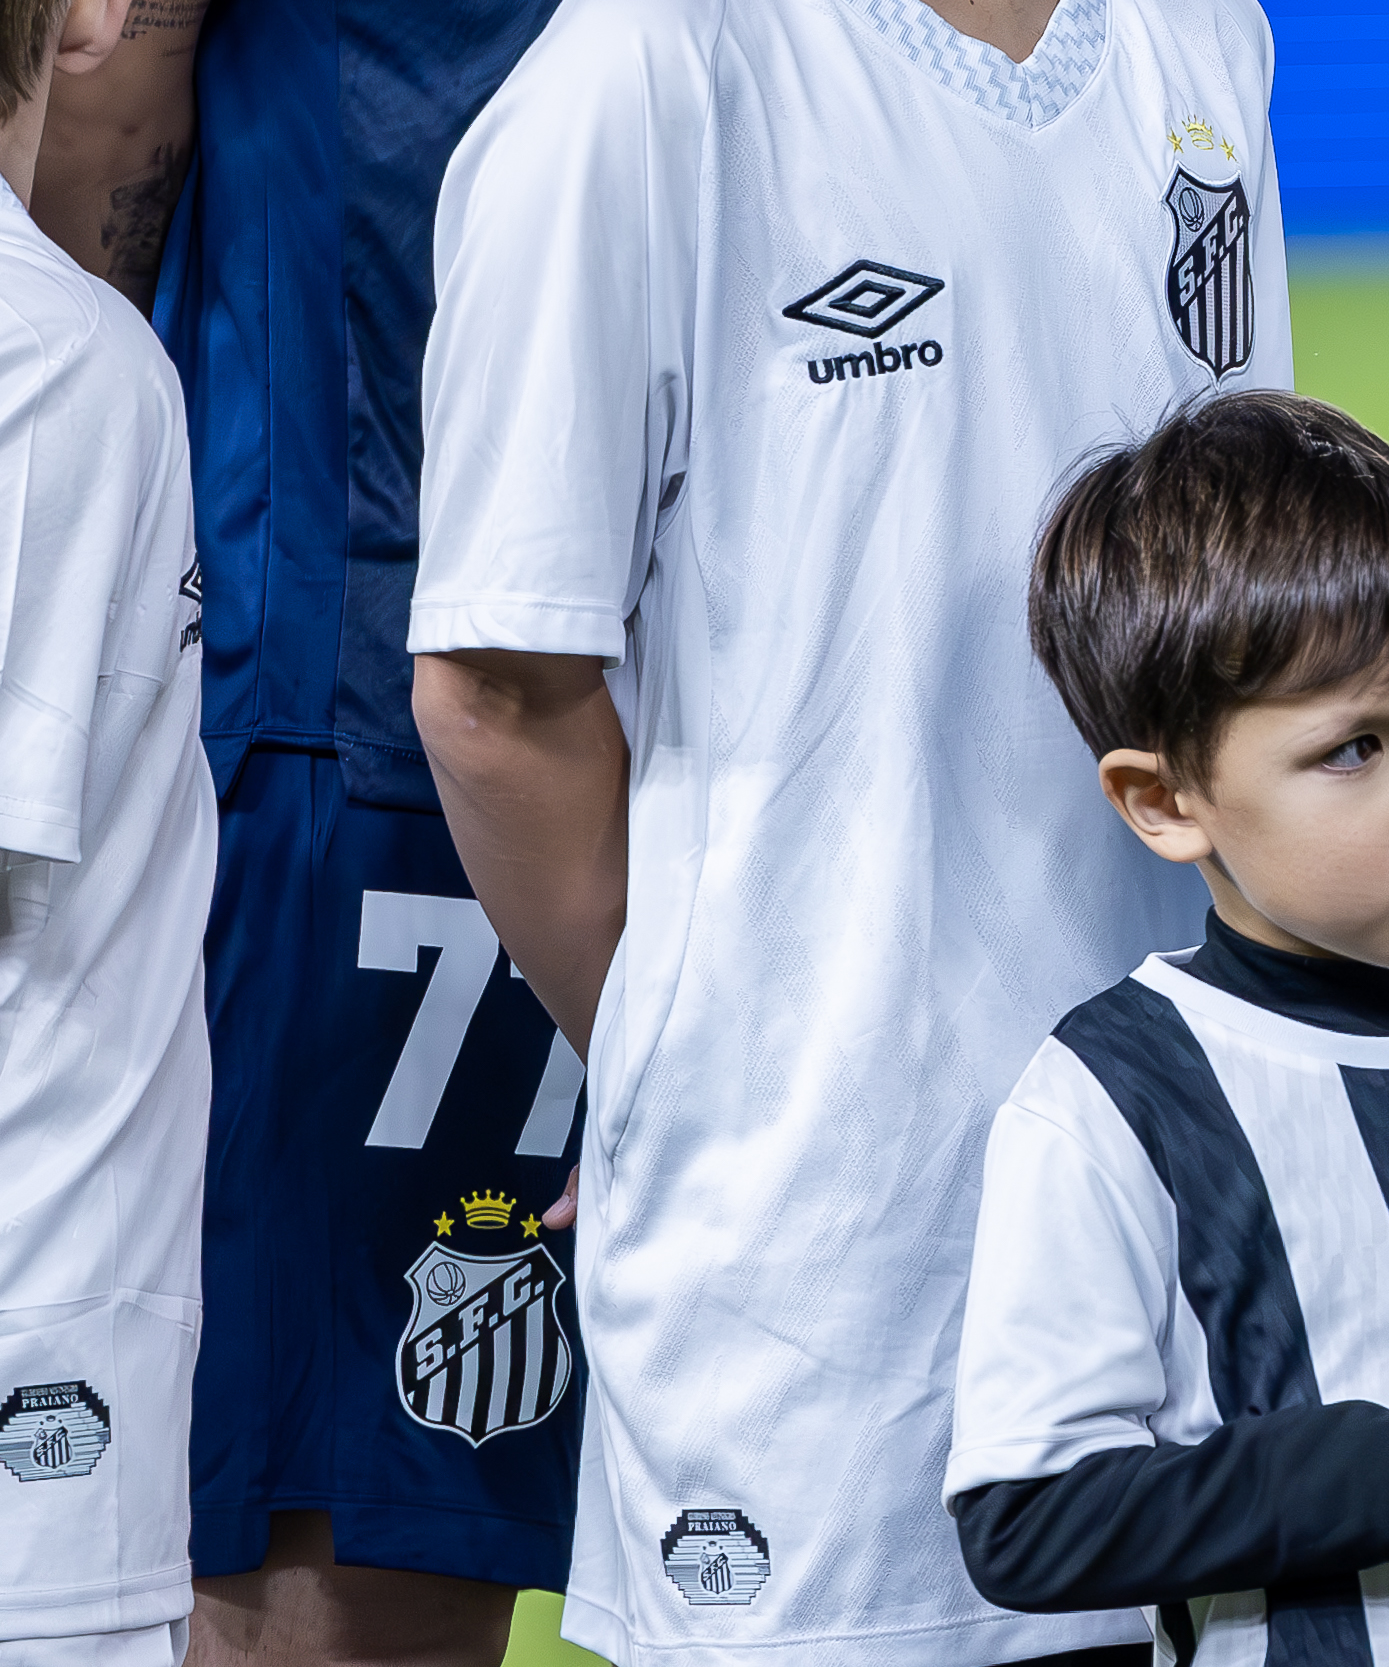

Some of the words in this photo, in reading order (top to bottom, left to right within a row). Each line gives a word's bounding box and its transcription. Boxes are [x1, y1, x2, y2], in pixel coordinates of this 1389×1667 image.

[807, 340, 943, 384] umbro
[415, 1262, 545, 1381] S.F.C.
[22, 1394, 79, 1409] PRAIANO
[687, 1521, 737, 1532] PRAIANO
